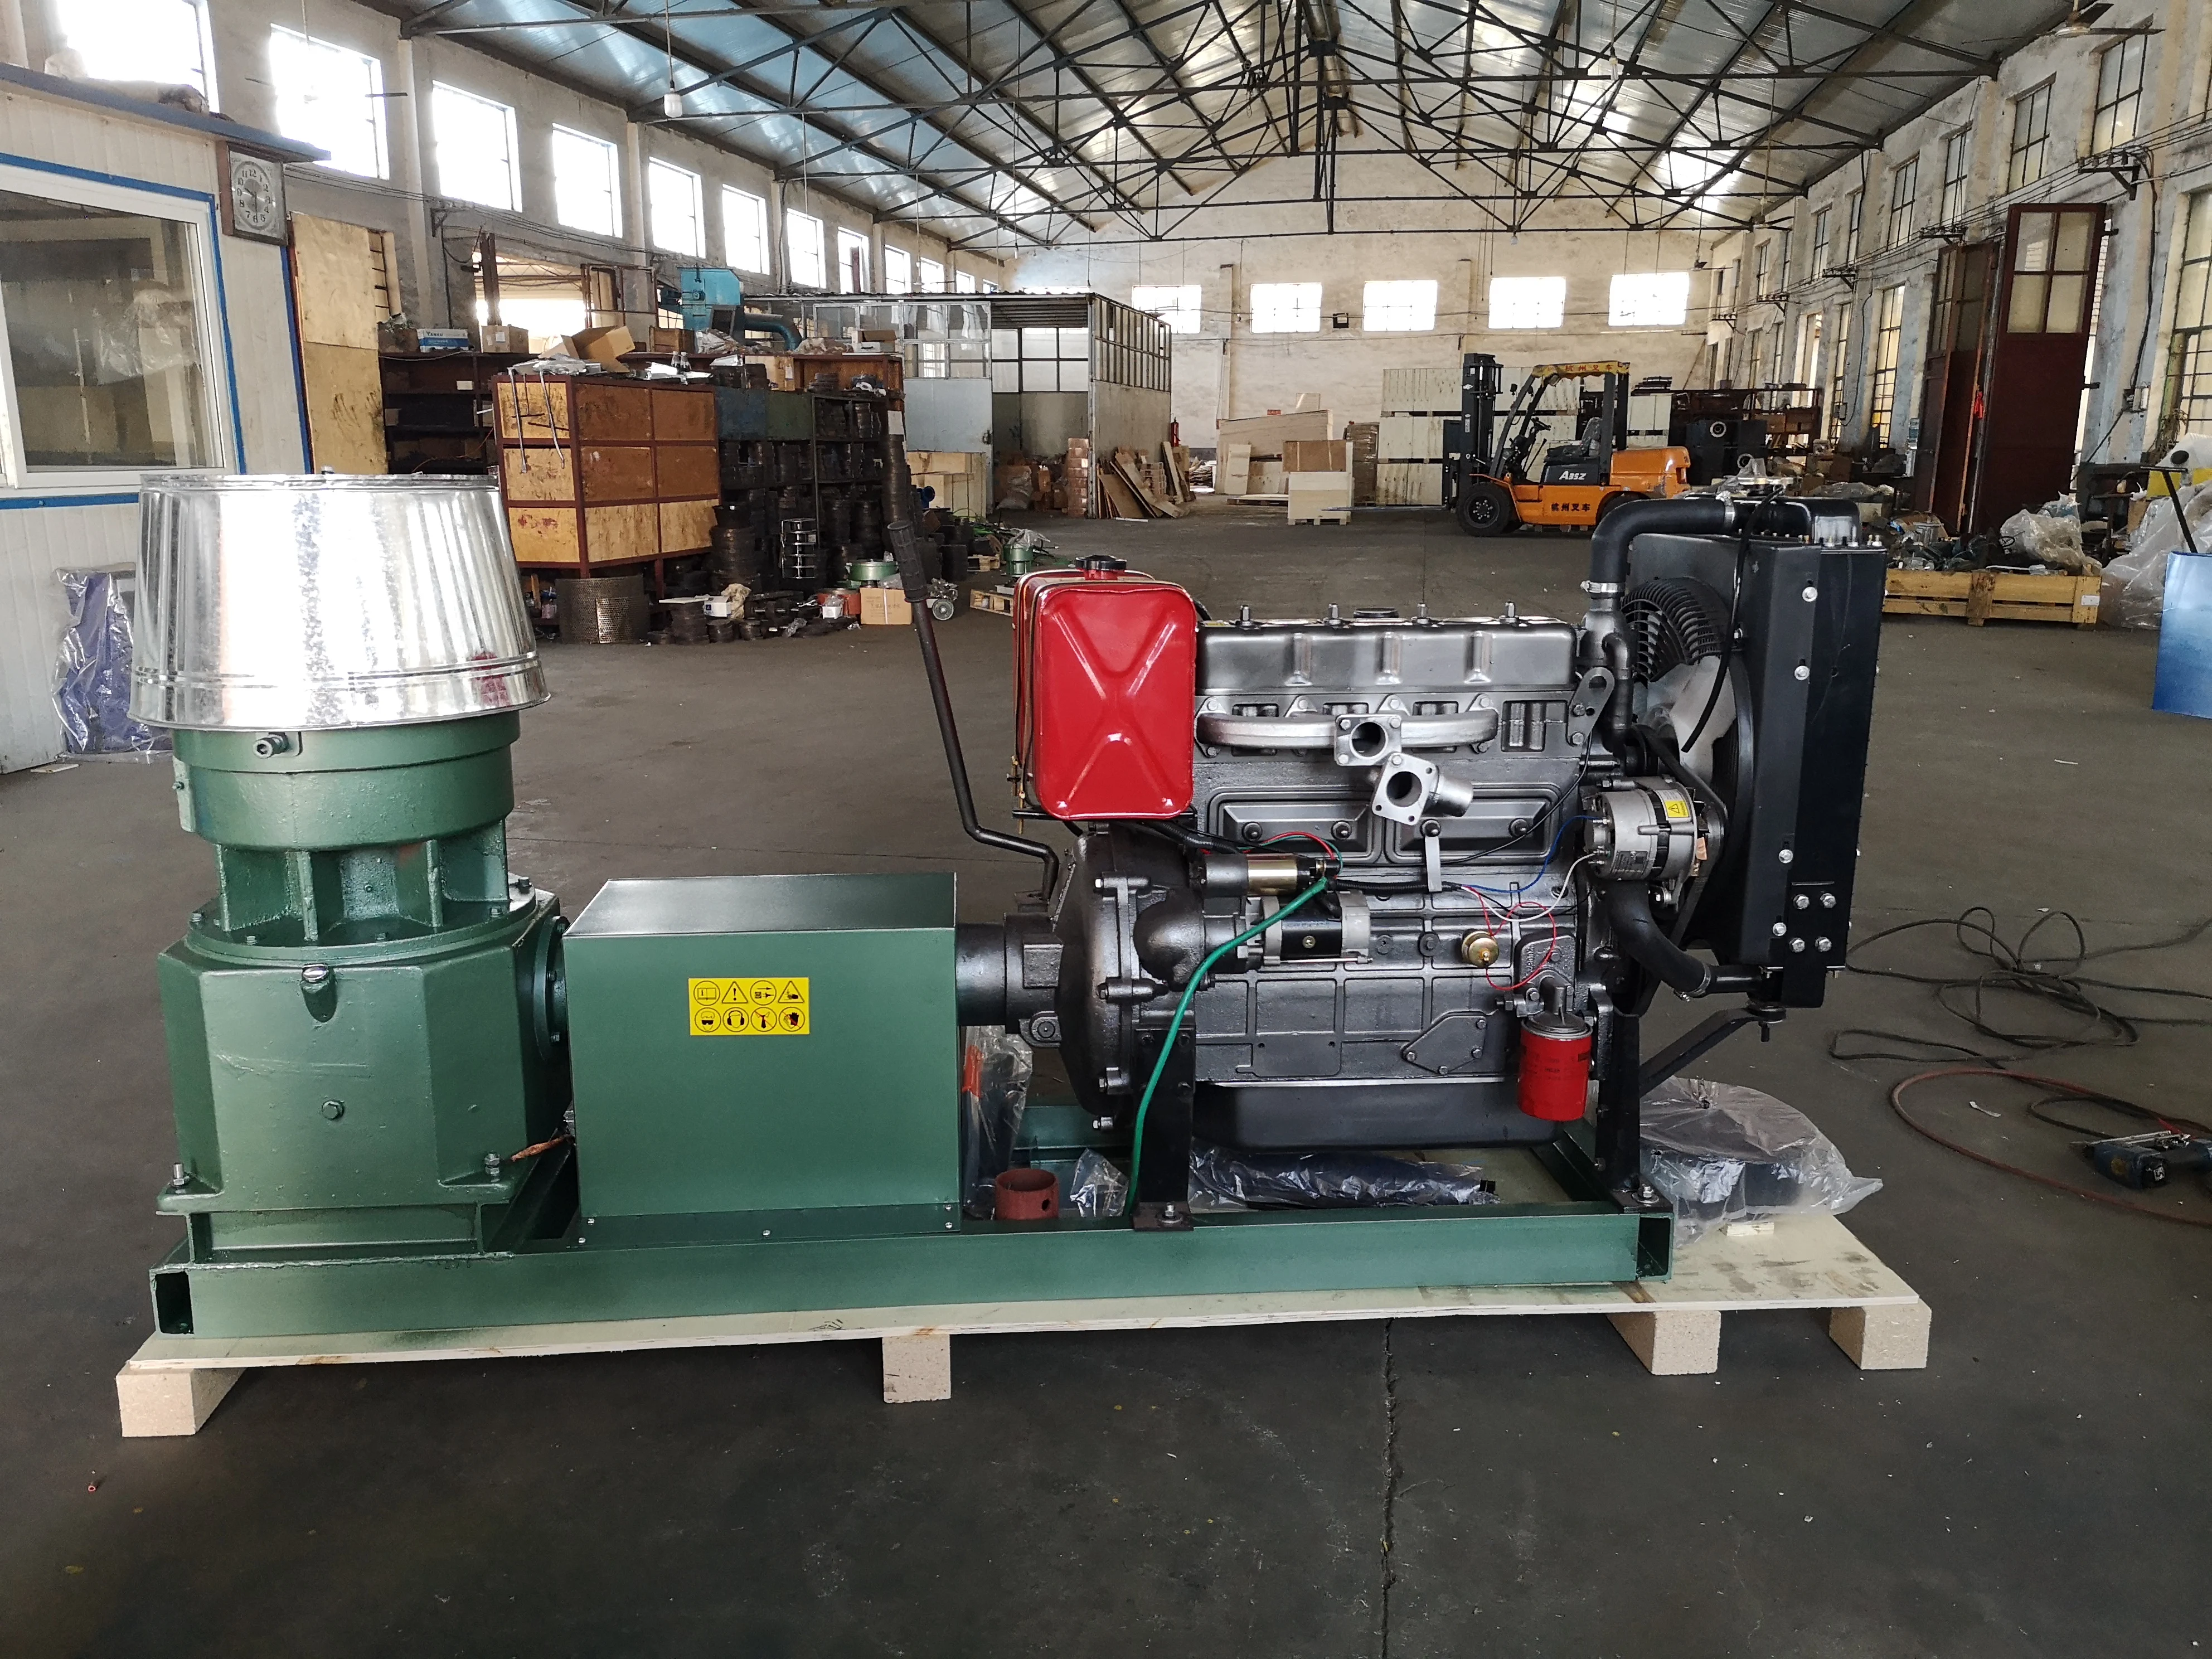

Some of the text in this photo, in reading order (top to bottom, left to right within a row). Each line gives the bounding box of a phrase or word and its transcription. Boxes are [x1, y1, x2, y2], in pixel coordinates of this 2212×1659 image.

[249, 169, 256, 177] 12
[237, 188, 242, 196] 9
[253, 215, 258, 223] 6
